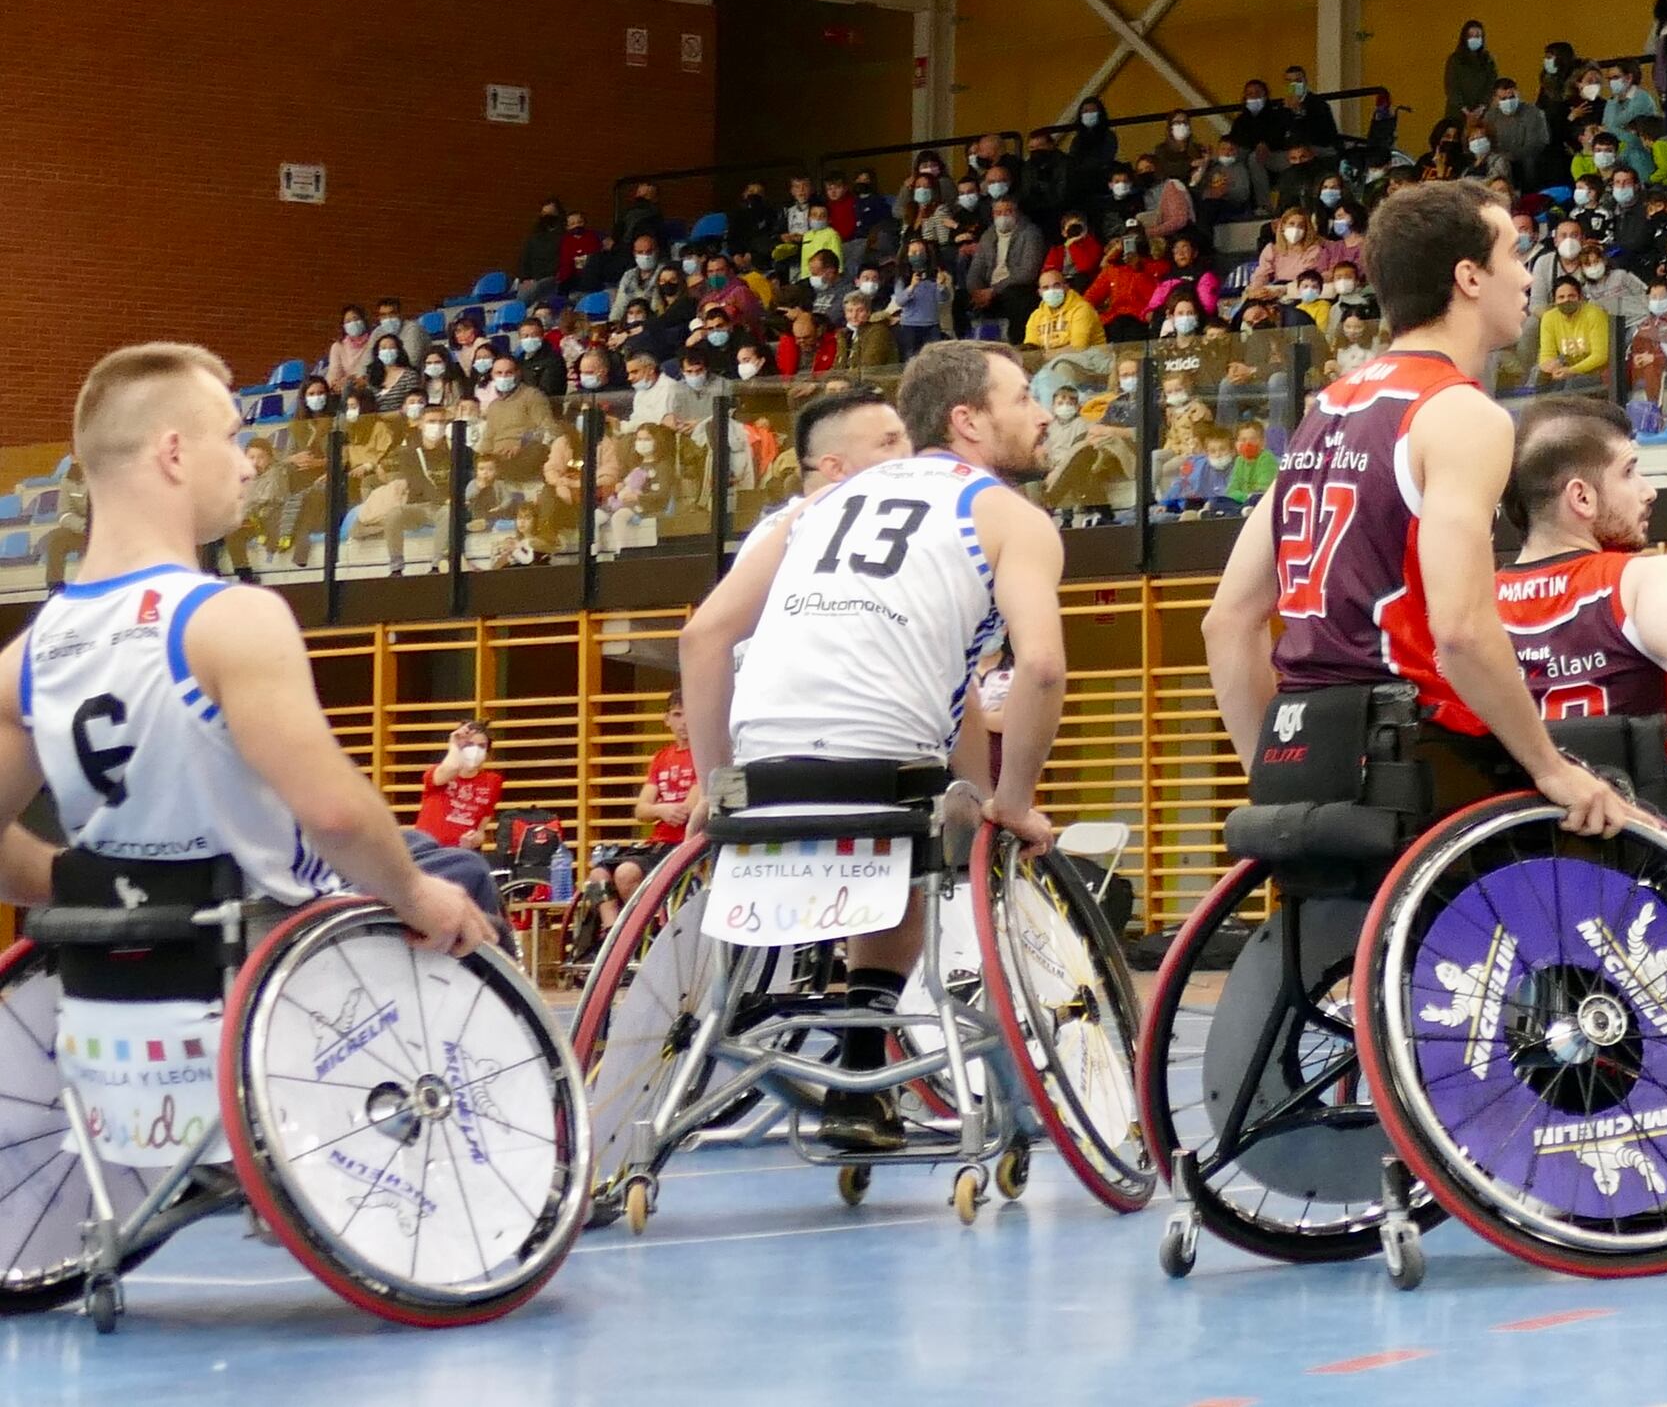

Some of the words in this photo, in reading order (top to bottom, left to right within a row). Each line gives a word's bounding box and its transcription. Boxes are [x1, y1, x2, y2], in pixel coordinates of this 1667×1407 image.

[813, 494, 931, 579] 13
[1278, 483, 1357, 618] 27
[1498, 575, 1567, 602] MARTIN
[1547, 652, 1607, 679] álava
[731, 864, 814, 878] CASTILLA
[822, 864, 834, 877] Y
[840, 861, 890, 878] LEÓN
[726, 901, 761, 932] es
[775, 886, 883, 932] vida
[1470, 931, 1518, 1080] MICHELIN
[315, 1006, 400, 1082] MICHELIN
